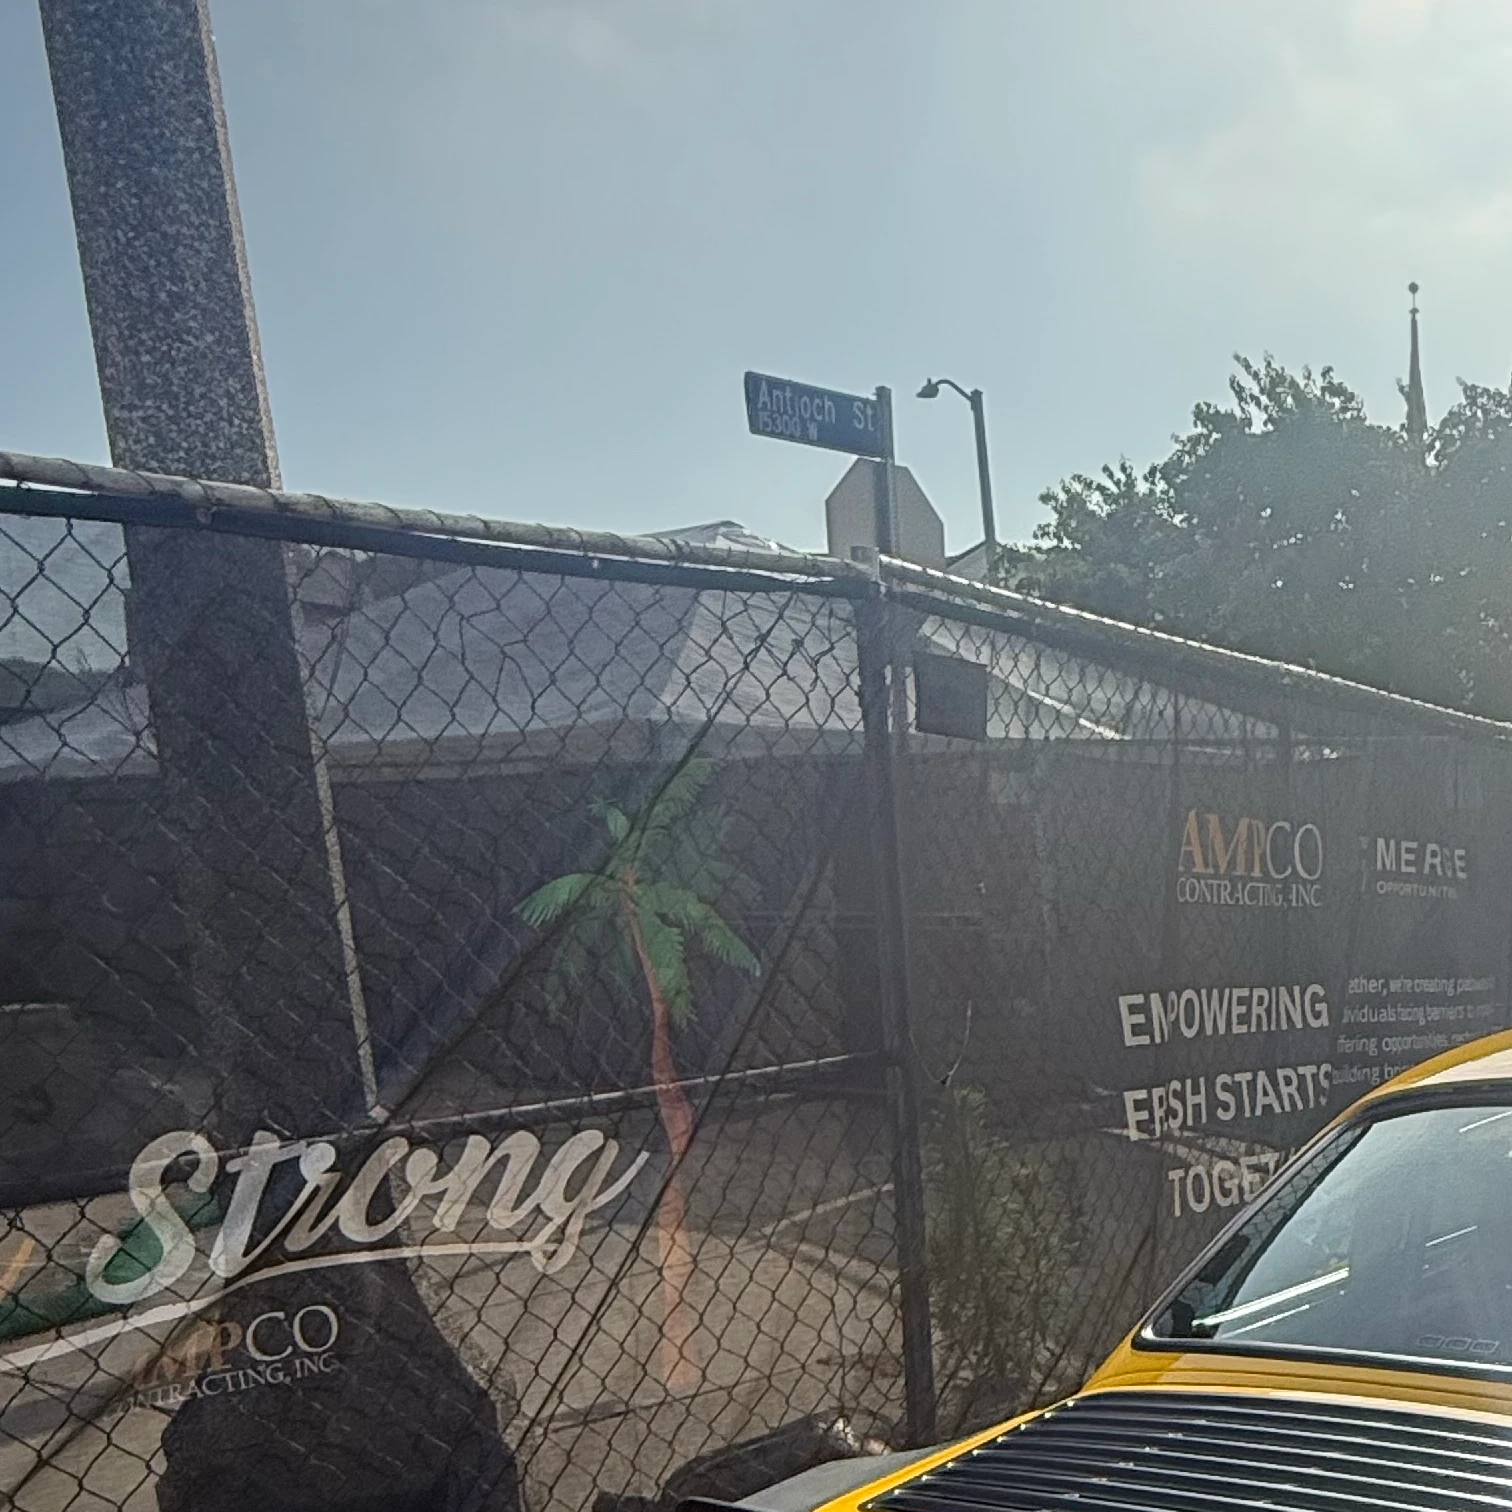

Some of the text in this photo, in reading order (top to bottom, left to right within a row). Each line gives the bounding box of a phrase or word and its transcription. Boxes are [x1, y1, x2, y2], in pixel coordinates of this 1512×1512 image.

[757, 379, 875, 431] Antioch St
[758, 410, 801, 437] 15300
[1178, 808, 1324, 881] AMPCO
[1214, 1063, 1333, 1122] STARTS
[1168, 1150, 1282, 1218] TOGET
[86, 1130, 650, 1304] Strong
[115, 1352, 336, 1412] ONTRACTING, INC
